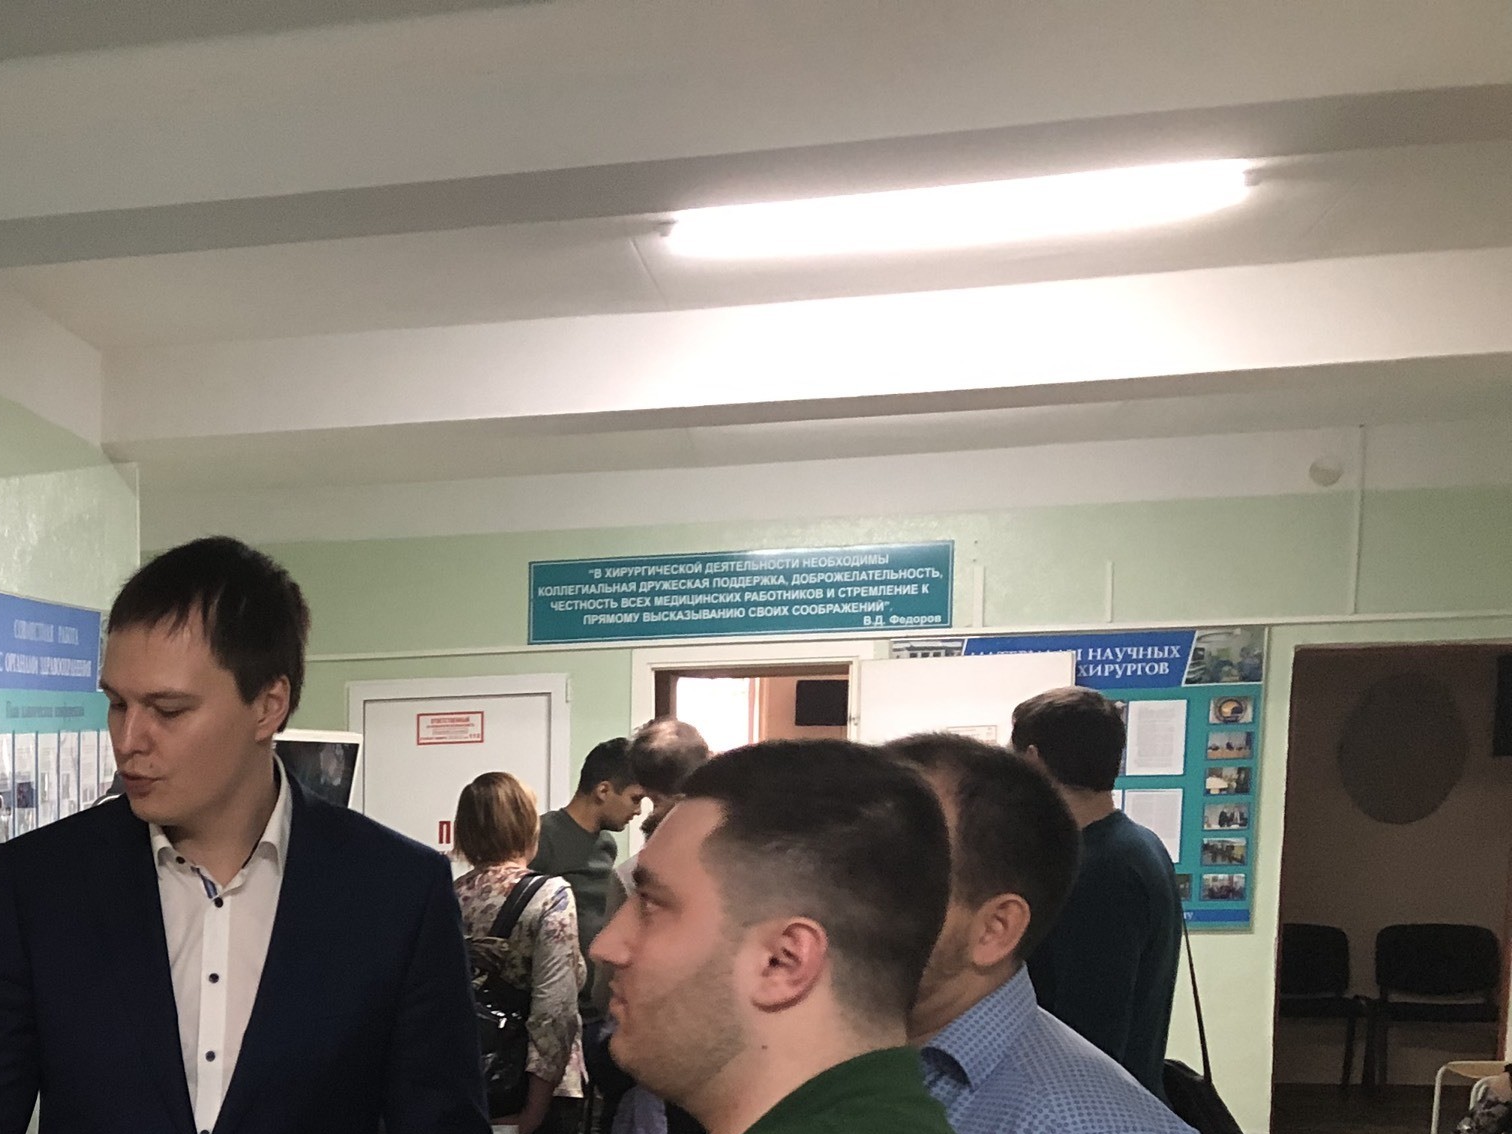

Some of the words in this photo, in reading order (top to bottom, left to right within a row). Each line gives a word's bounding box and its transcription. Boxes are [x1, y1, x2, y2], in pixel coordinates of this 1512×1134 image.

[605, 561, 703, 578] ХИРУРГИЧЕСКОЙ
[705, 557, 800, 574] ДЕЯТЕЛЬНОСТИ
[803, 554, 889, 568] НЕОБХОДИМЫ
[538, 581, 637, 597] КОЛЛЕГИАЛЬНАЯ
[638, 576, 710, 593] ДРУЖЕСКАЯ
[550, 600, 619, 612] ЧЕСТНОСТЬ
[621, 597, 652, 608] ВСЕХ
[654, 592, 741, 607] МЕДИЦИНСКИХ
[744, 588, 824, 602] РАБОТНИКОВ
[826, 587, 835, 599] И
[838, 584, 919, 598] СТРЕМЛЕНИЕ
[921, 583, 930, 594] К
[583, 612, 640, 625] ПРЯМОМУ
[642, 607, 745, 623] ВЫСКАЗЫВАНИЮ
[748, 605, 790, 618] СВОИХ
[889, 614, 942, 628] Федоров
[1088, 645, 1181, 662] НАУЧНЫХ
[1077, 662, 1170, 679] ХИРУРГОВ
